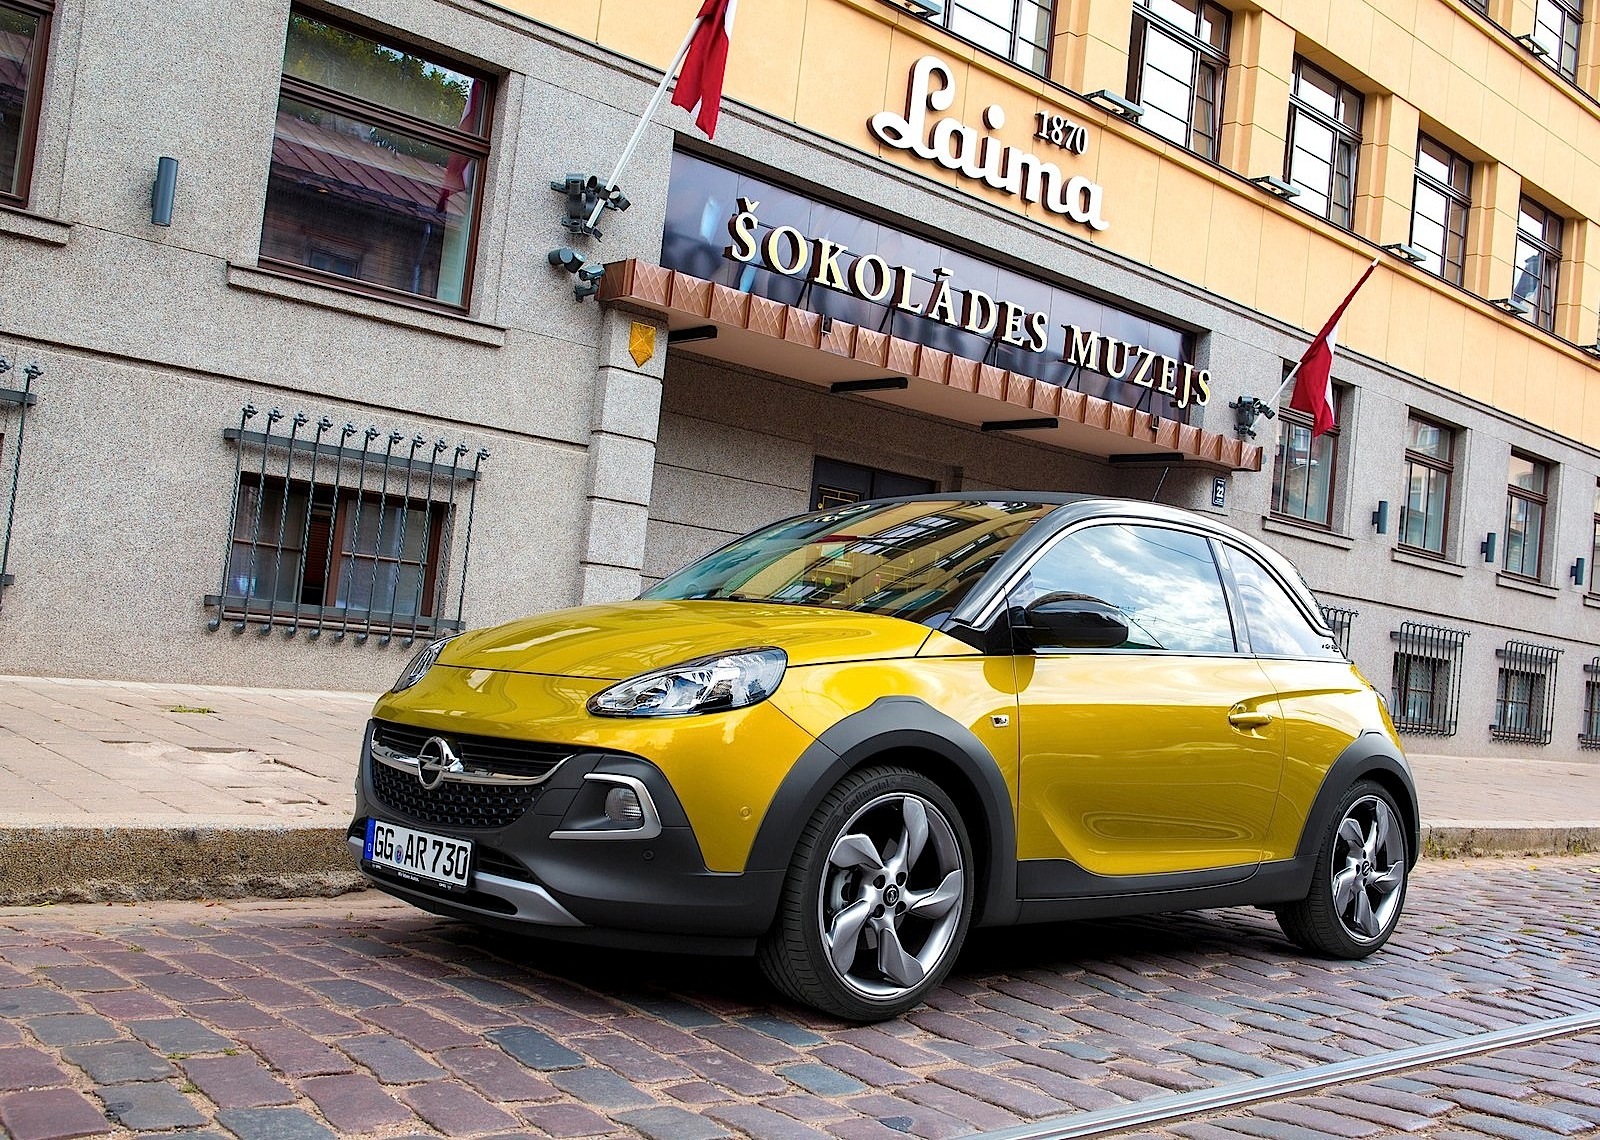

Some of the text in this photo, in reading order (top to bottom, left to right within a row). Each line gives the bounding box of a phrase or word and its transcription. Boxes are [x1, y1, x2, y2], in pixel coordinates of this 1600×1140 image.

[869, 55, 1110, 231] Laima
[1035, 110, 1089, 155] 1870
[724, 197, 1211, 409] ŠOKOLĀDES MUZEJS
[374, 825, 469, 880] GG AR 730
